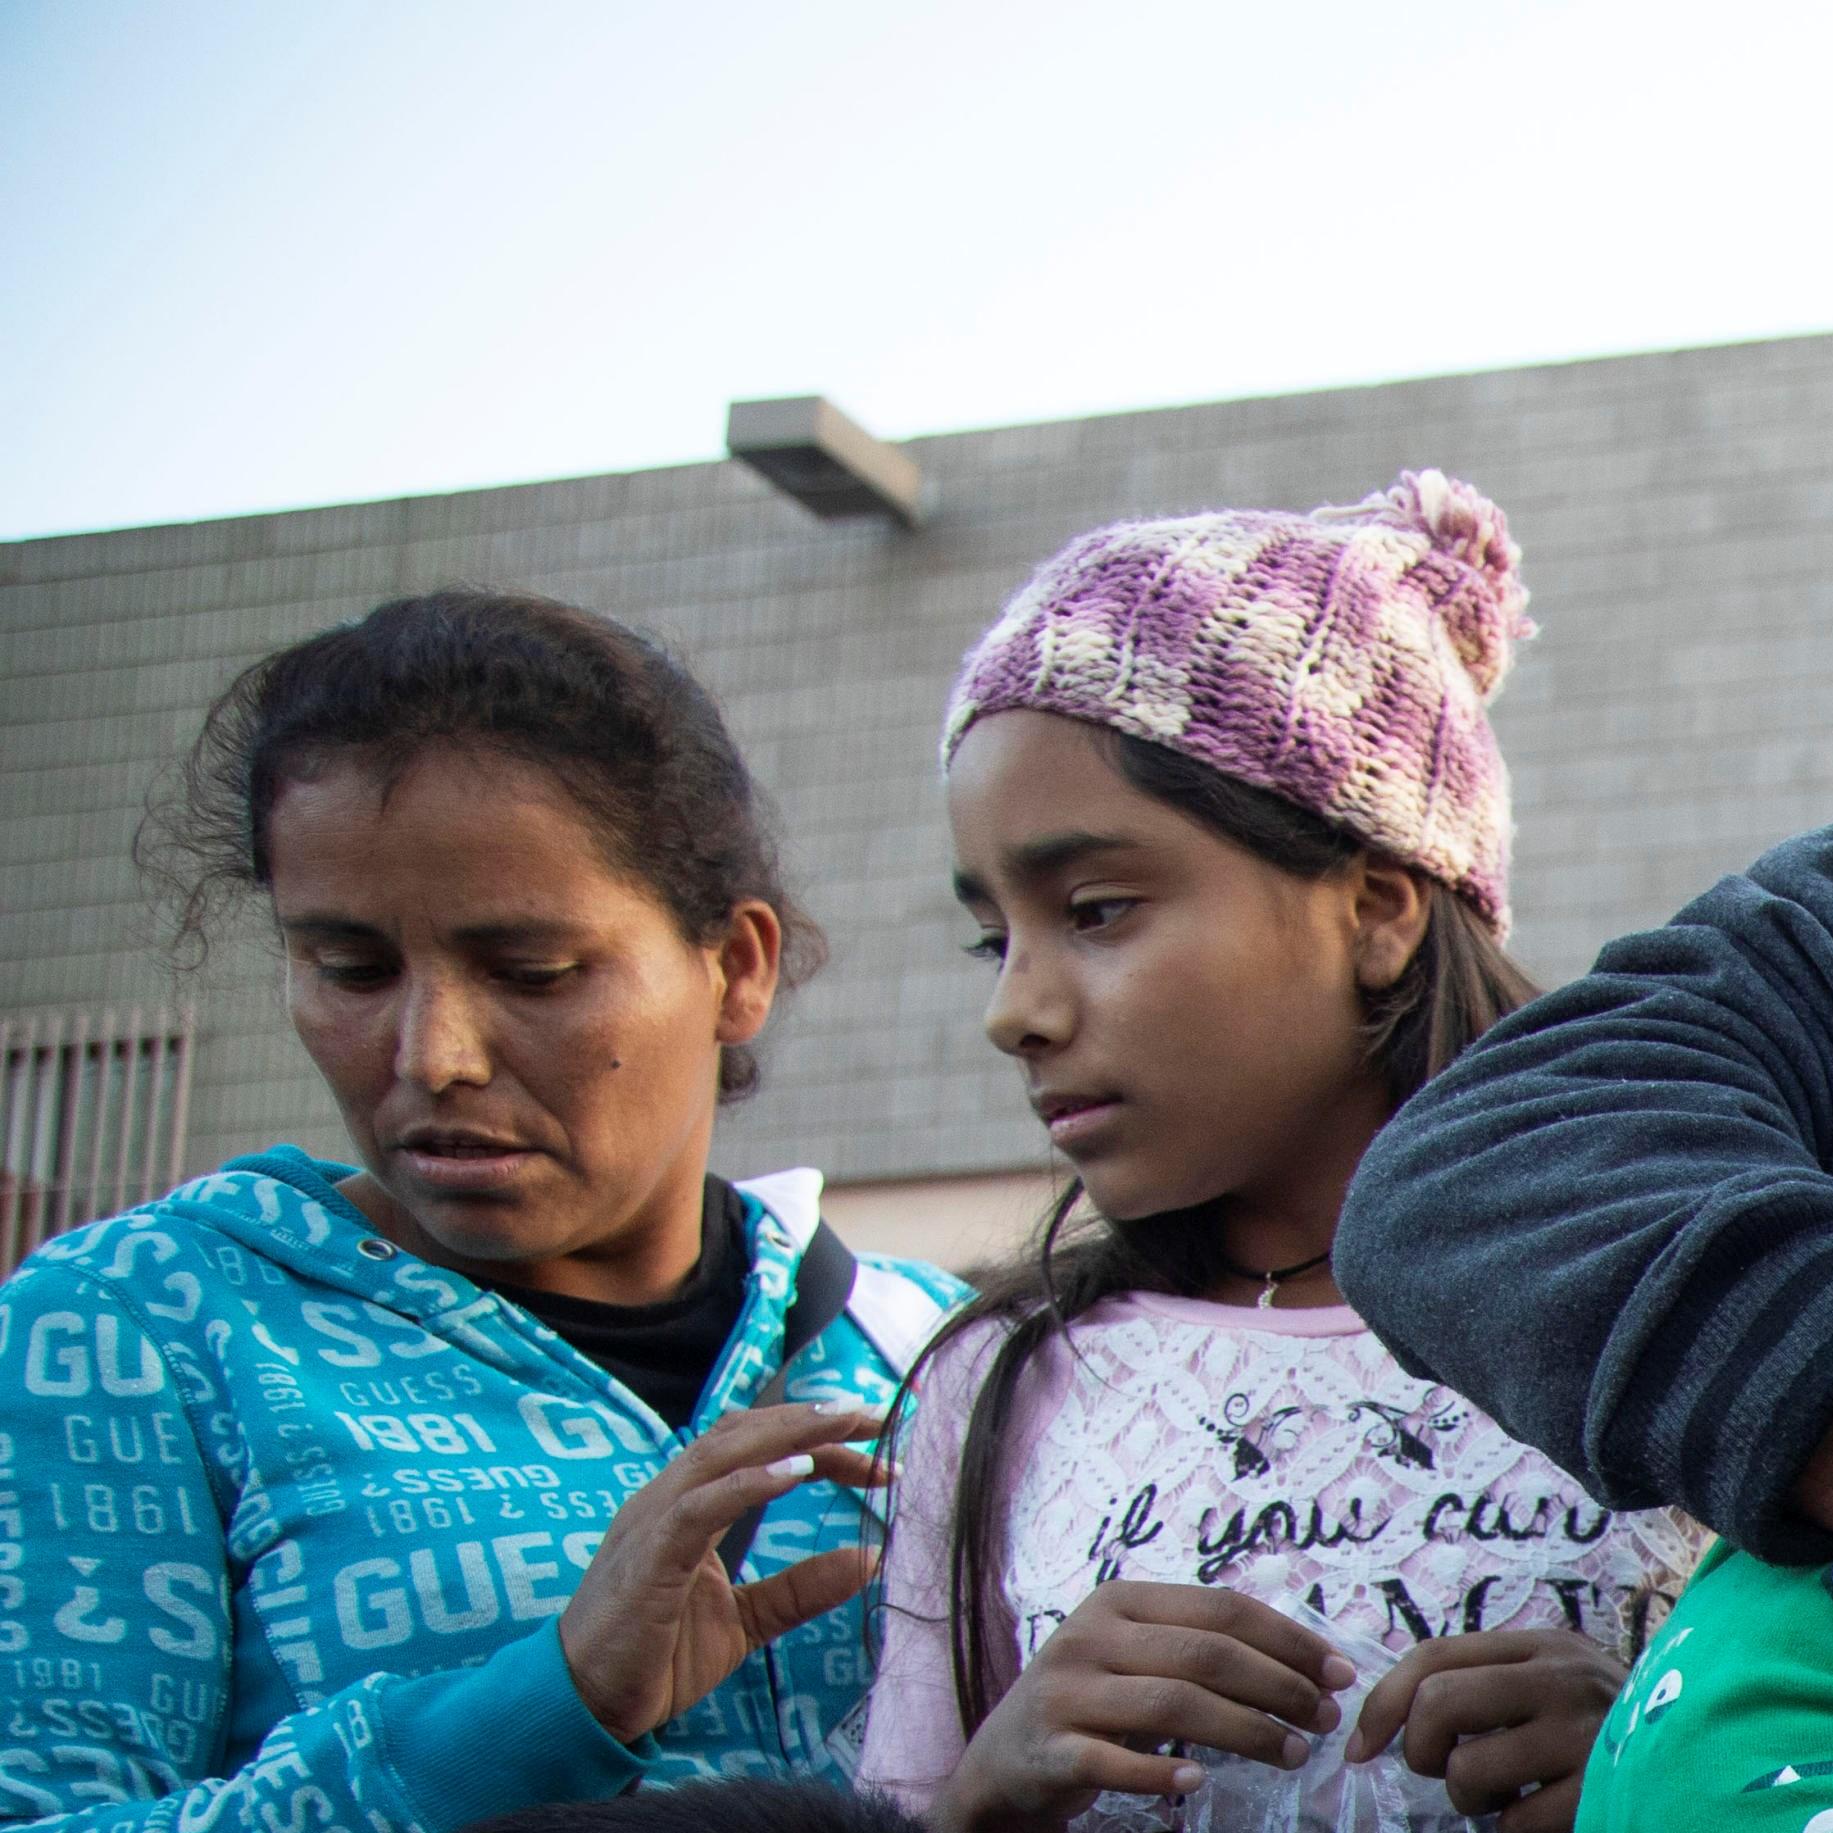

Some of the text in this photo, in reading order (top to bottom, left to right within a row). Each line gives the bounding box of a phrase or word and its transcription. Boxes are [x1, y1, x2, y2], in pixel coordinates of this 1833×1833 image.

[340, 1364, 482, 1407] GUESS
[334, 1411, 497, 1455] 1981
[393, 1464, 561, 1496] GUESS
[1198, 1495, 1392, 1585] you
